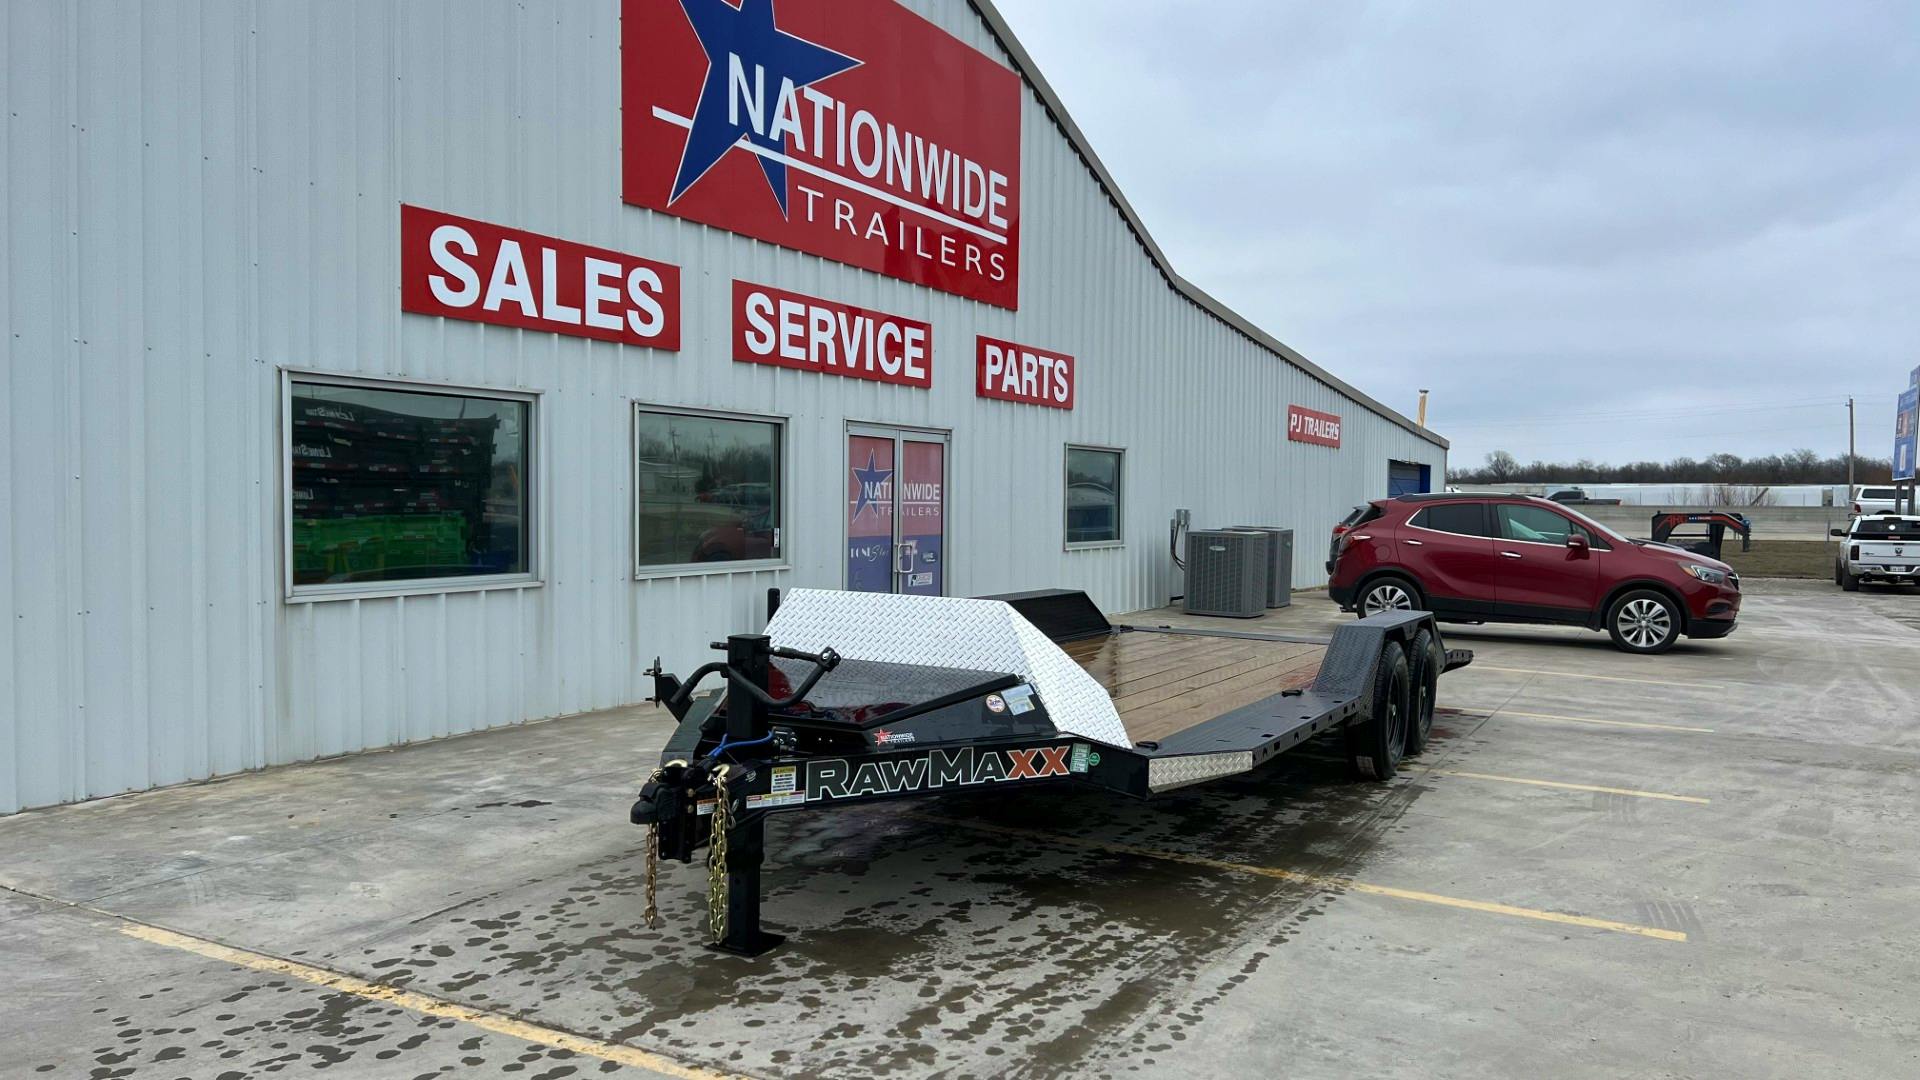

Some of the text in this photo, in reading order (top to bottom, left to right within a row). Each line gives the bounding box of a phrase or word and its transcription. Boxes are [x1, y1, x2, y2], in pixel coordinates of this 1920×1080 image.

[728, 51, 1008, 230] NATIONWIDE
[797, 185, 1007, 283] TRAILERS
[428, 224, 664, 338] SALES
[744, 292, 926, 380] SERVICE
[984, 344, 1070, 404] PARTS
[1289, 413, 1340, 441] PJ TRAILERS
[864, 480, 941, 501] NATINWIDE
